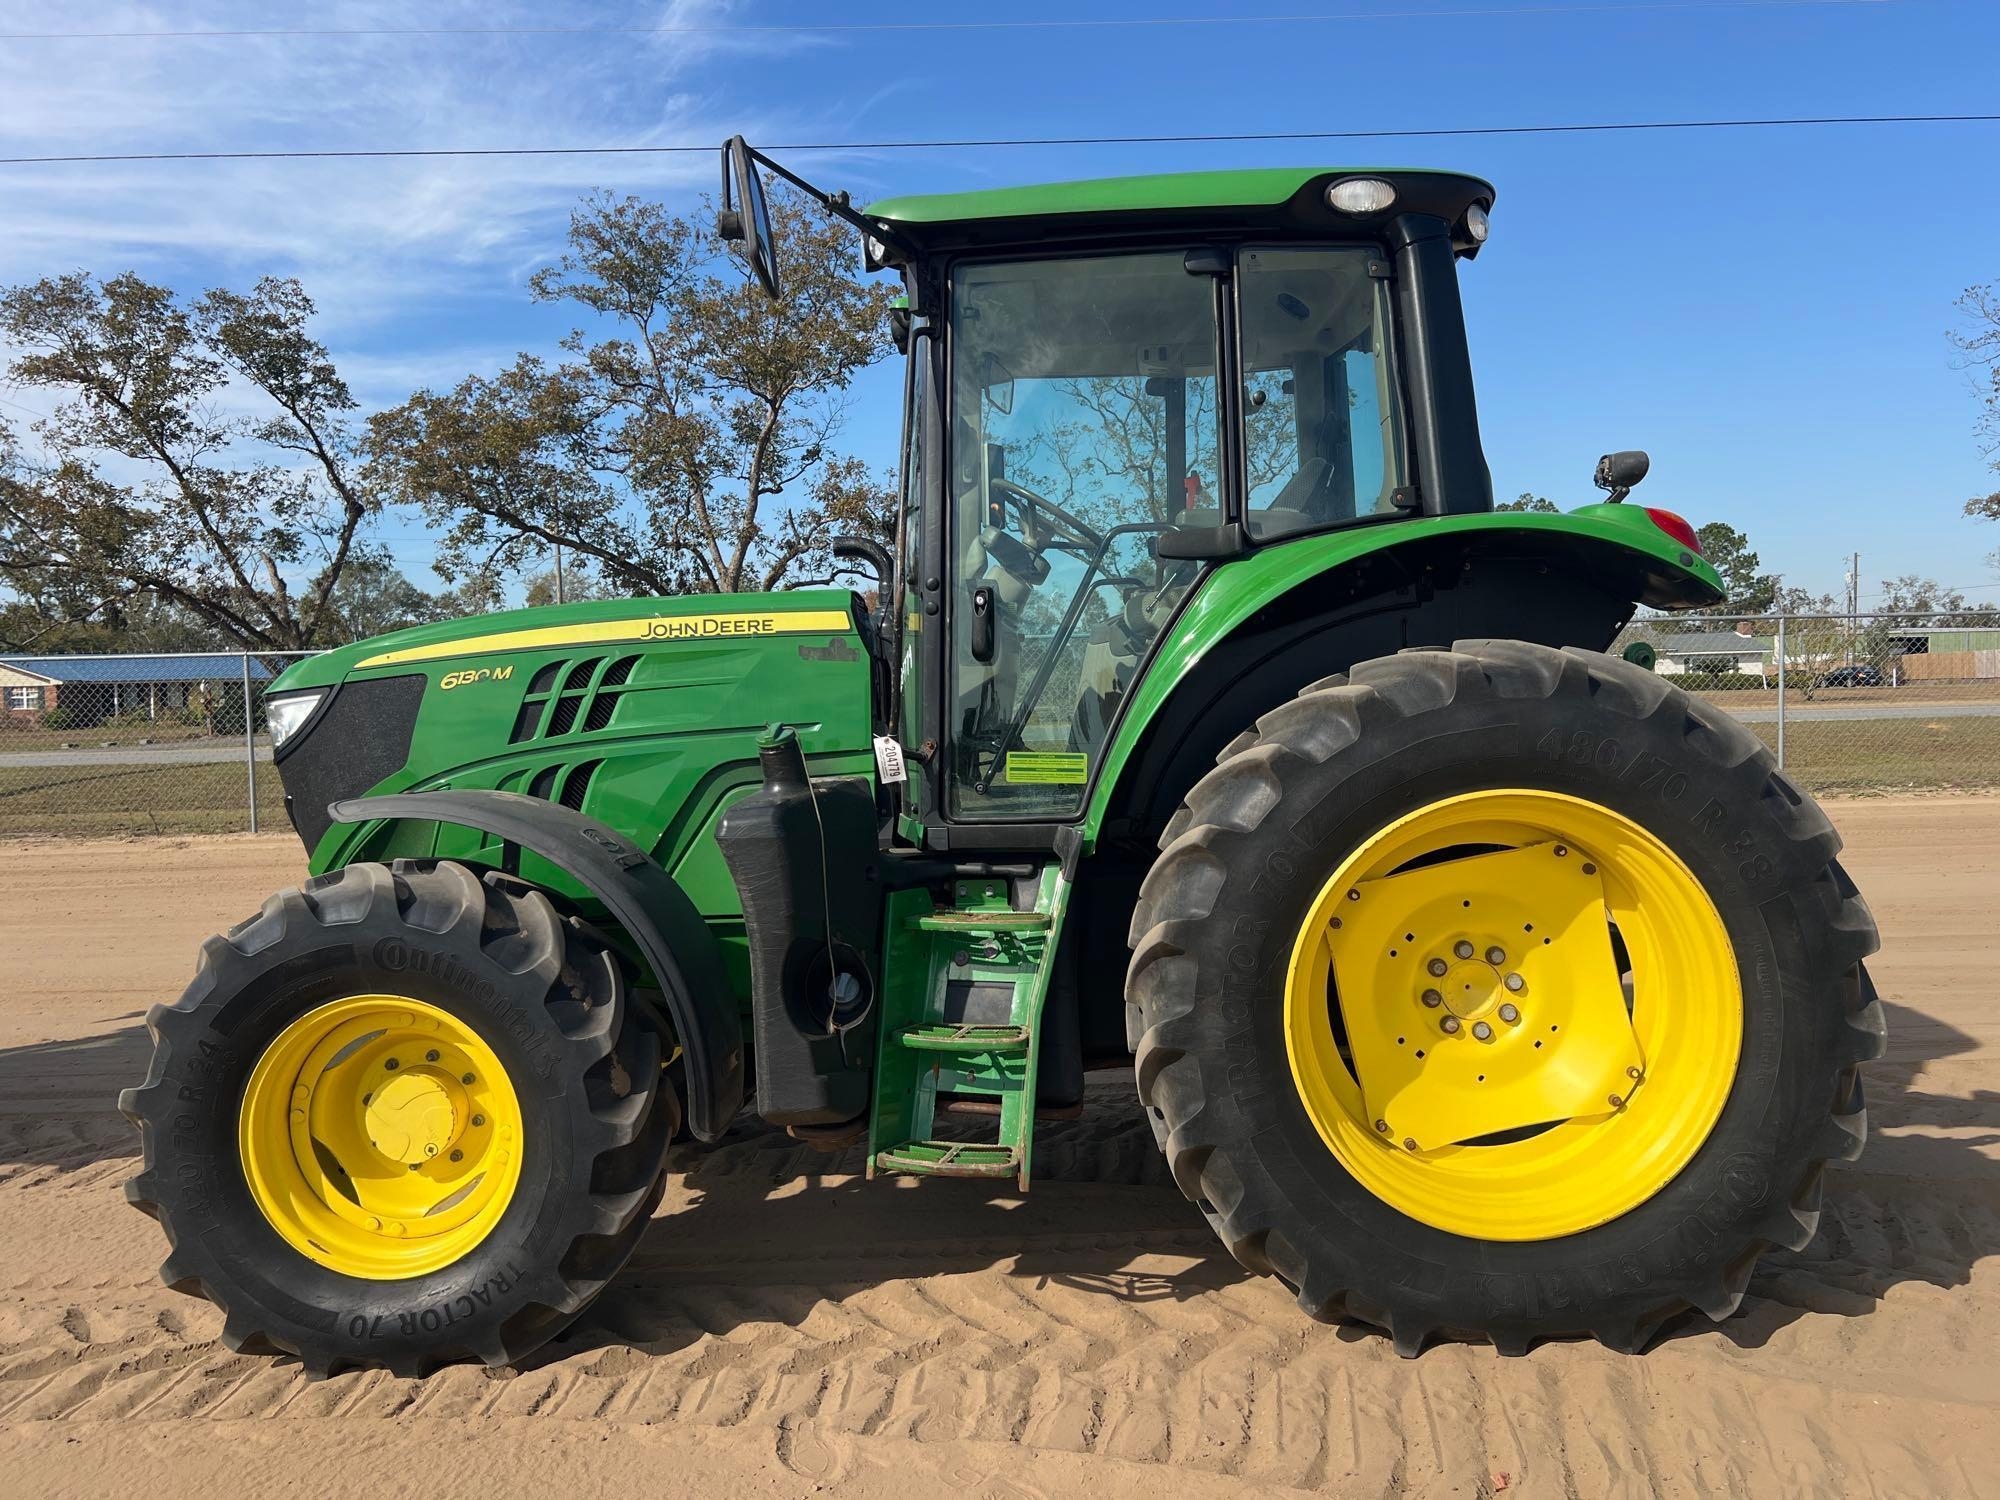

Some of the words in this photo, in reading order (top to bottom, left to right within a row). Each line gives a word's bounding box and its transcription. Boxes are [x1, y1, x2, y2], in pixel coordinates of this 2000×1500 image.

[640, 621, 699, 638] JOHN
[702, 618, 775, 634] DEERE
[884, 746, 901, 777] 204779
[1536, 727, 1690, 801] 480/70
[1690, 796, 1728, 834] R
[1720, 829, 1775, 883] 38
[1220, 914, 1273, 1117] TRACTOR
[1249, 849, 1299, 906] 70
[399, 1261, 529, 1337] TRACTOR
[348, 1314, 385, 1341] 70
